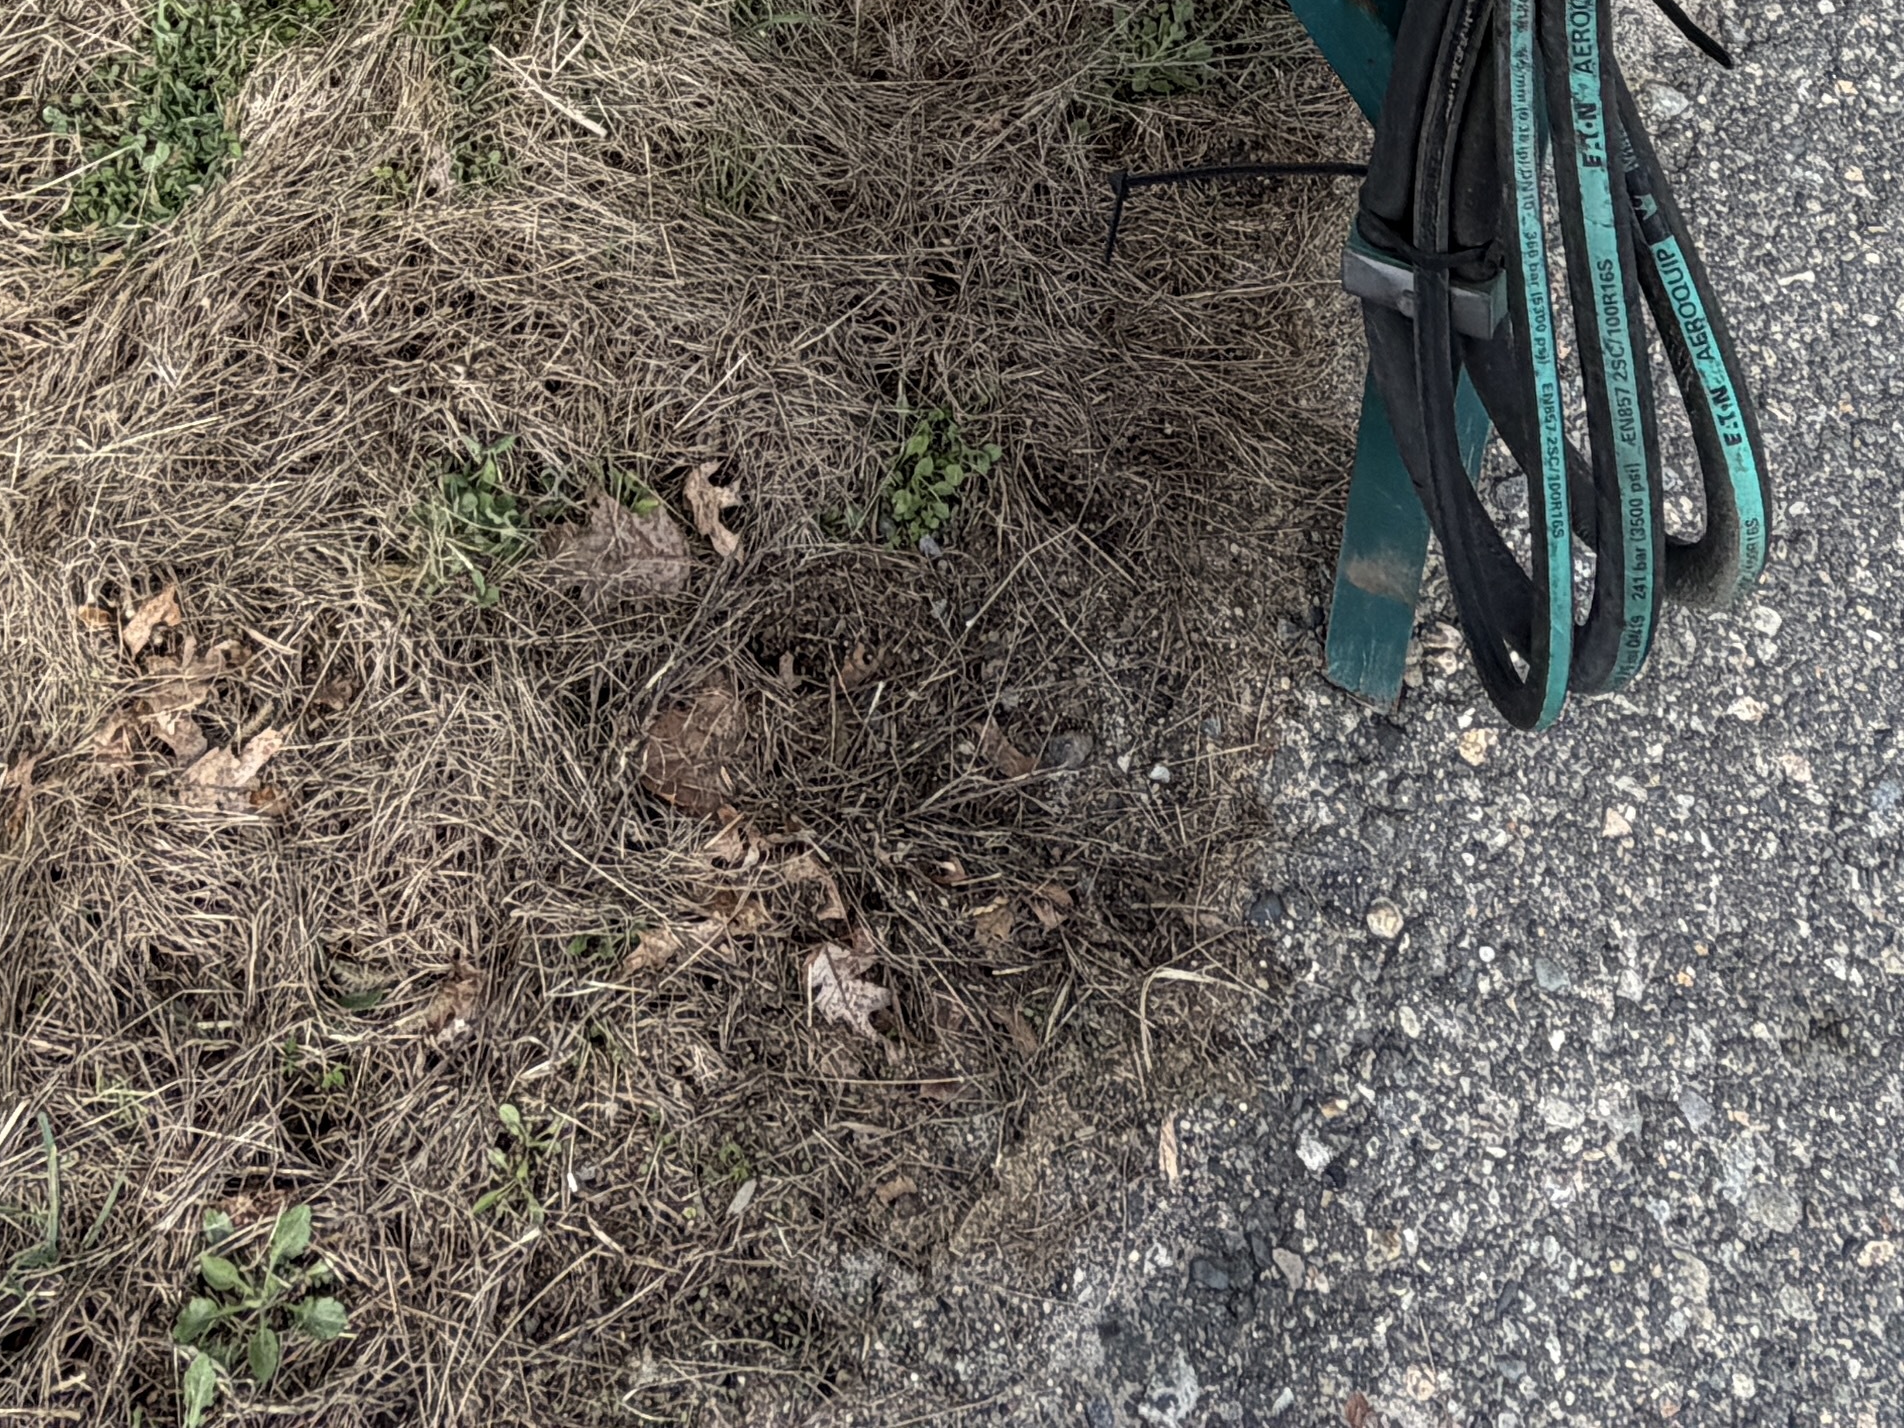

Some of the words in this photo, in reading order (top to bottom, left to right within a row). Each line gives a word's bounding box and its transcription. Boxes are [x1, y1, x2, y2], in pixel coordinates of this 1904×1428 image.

[1528, 261, 1541, 288] bar
[1596, 257, 1629, 382] 2SC/100R16S
[1656, 248, 1716, 361] AEROQUIP
[1616, 387, 1637, 442] EN857
[1630, 499, 1647, 544] (3500
[1633, 546, 1648, 574] bar
[1631, 580, 1647, 601] 241
